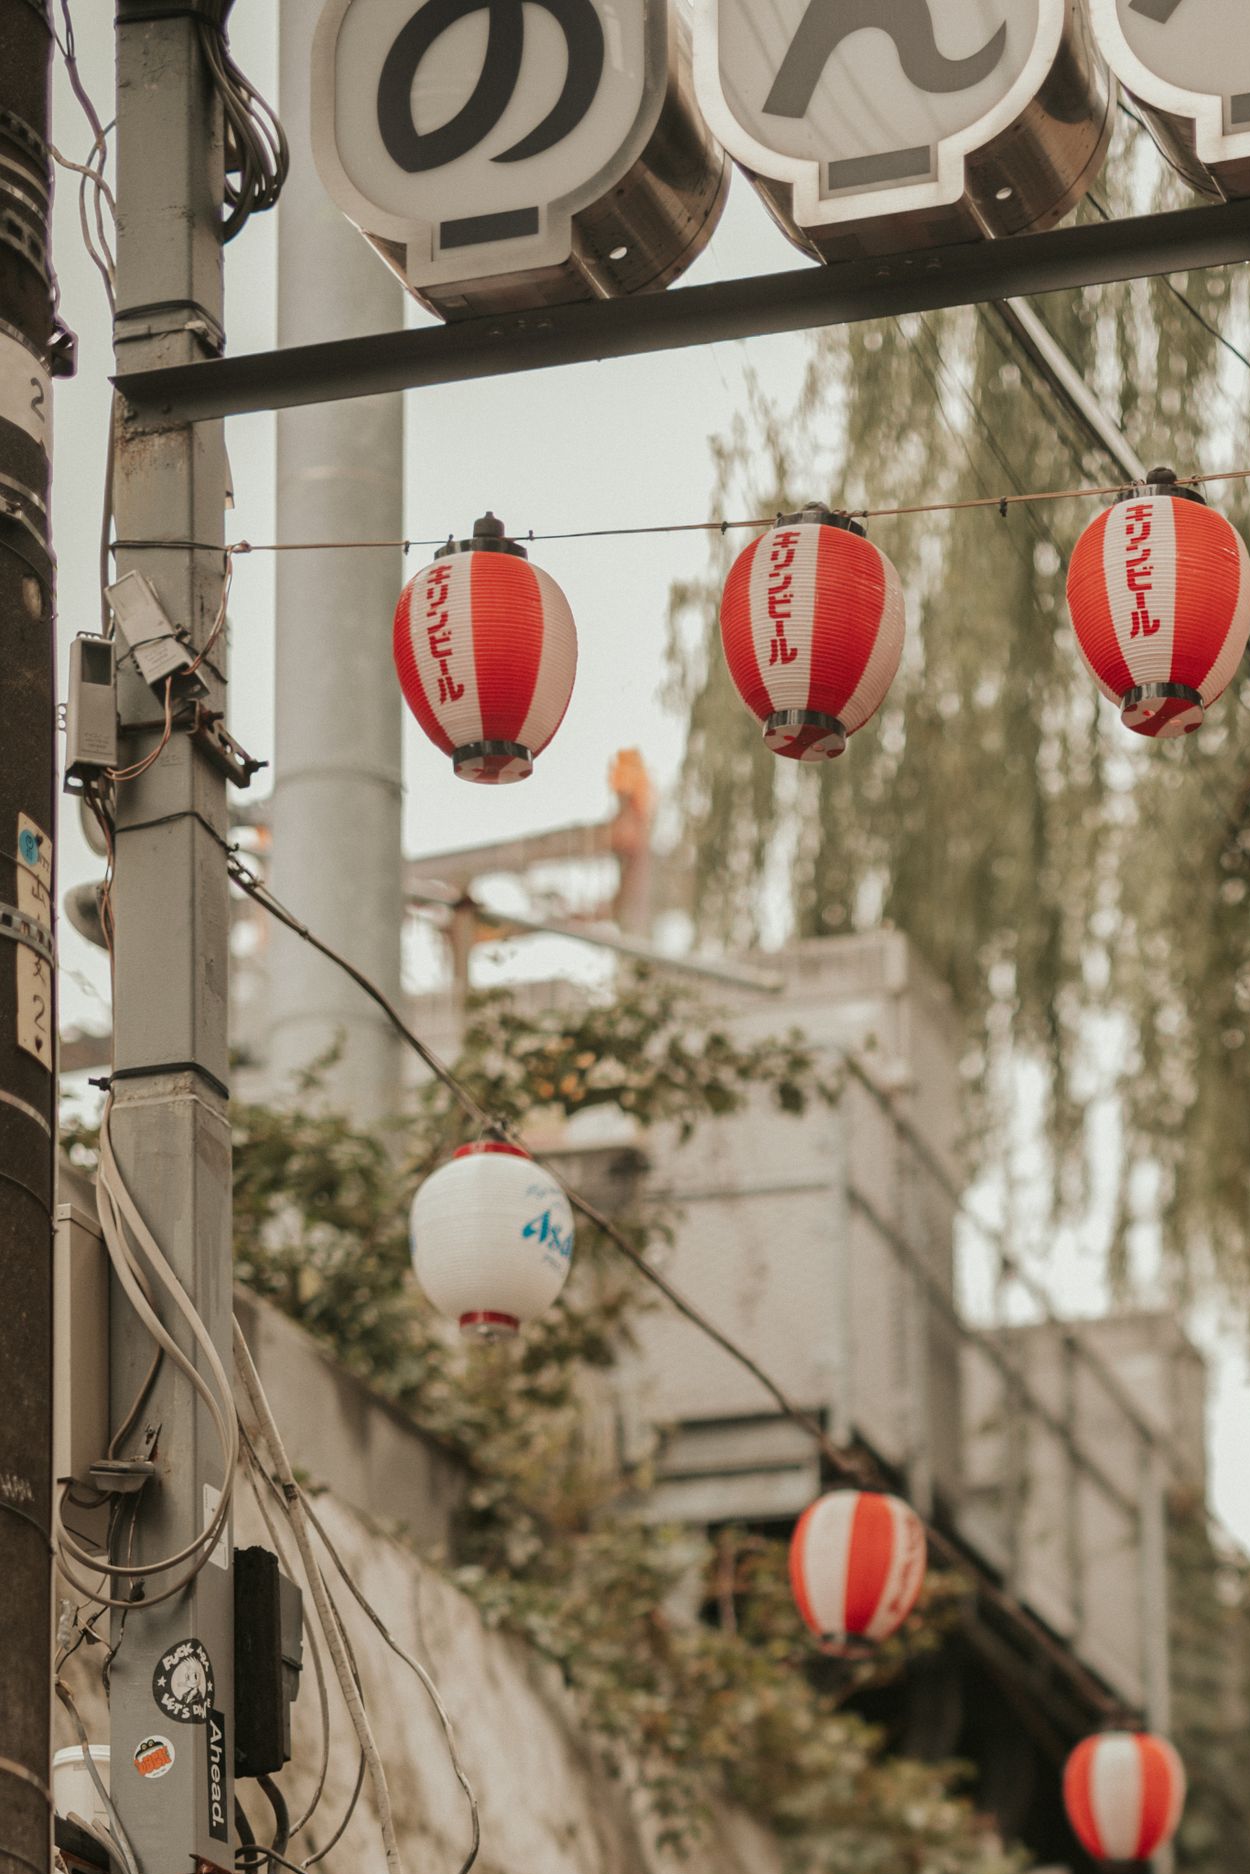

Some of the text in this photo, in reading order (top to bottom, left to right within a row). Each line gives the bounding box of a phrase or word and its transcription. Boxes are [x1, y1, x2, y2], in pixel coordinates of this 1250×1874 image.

[427, 565, 465, 705] キリンビール
[768, 531, 801, 667] キリンビール
[1126, 504, 1161, 640] キリンビール
[161, 1693, 190, 1719] LET'S
[209, 1719, 225, 1828] Ahead.
